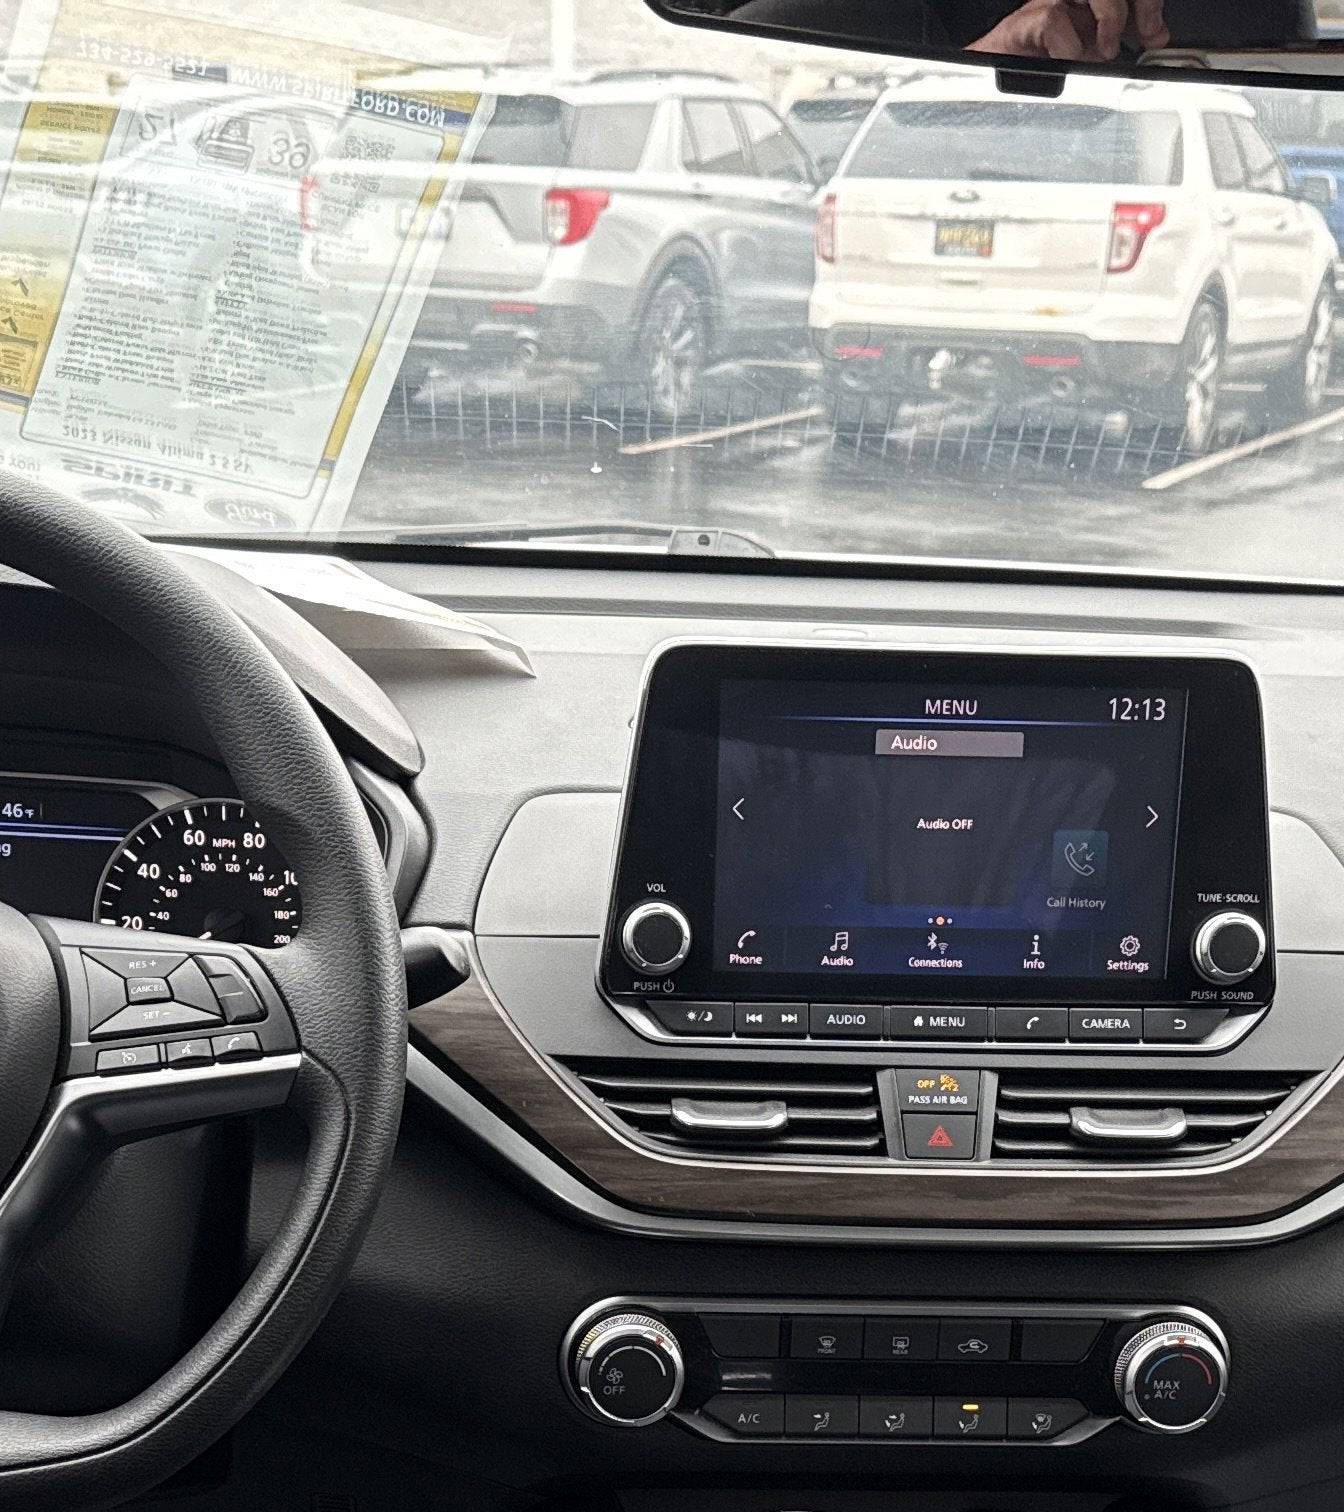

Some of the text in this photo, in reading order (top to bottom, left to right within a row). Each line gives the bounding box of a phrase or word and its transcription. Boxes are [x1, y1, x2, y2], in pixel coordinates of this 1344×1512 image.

[924, 699, 977, 716] MENU
[1108, 697, 1167, 722] 12:13
[890, 734, 938, 751] Audio
[916, 817, 973, 831] Audio OFF
[183, 829, 206, 846] 60
[212, 838, 236, 849] MPH
[242, 832, 266, 849] 80
[137, 863, 161, 880] 40
[200, 862, 217, 872] 100
[224, 862, 241, 873] 120
[178, 873, 193, 883] 80
[248, 871, 265, 882] 140
[165, 889, 178, 898] 60
[262, 887, 279, 897] 160
[646, 882, 667, 893] VOL
[1046, 896, 1107, 911] Call History
[156, 910, 170, 920] 40
[274, 911, 290, 920] 180
[121, 915, 144, 931] 20
[273, 934, 291, 944] 200
[728, 953, 763, 966] Phone
[820, 954, 854, 967] Audio
[907, 956, 964, 969] Connections
[1022, 957, 1046, 971] Info
[1106, 960, 1150, 973] Settings
[130, 983, 167, 995] CANCEL
[633, 981, 661, 992] PUSH
[1190, 990, 1255, 1001] PUSH SOUND
[826, 1013, 867, 1025] AUDIO
[929, 1015, 967, 1028] MENU
[1081, 1018, 1132, 1031] CAMERA
[916, 1079, 936, 1089] OFF
[907, 1095, 968, 1105] PASS AIR BAG
[602, 1385, 627, 1396] OFF
[1153, 1379, 1181, 1391] MAX
[1154, 1389, 1177, 1400] A/C
[737, 1412, 761, 1424] A/C
